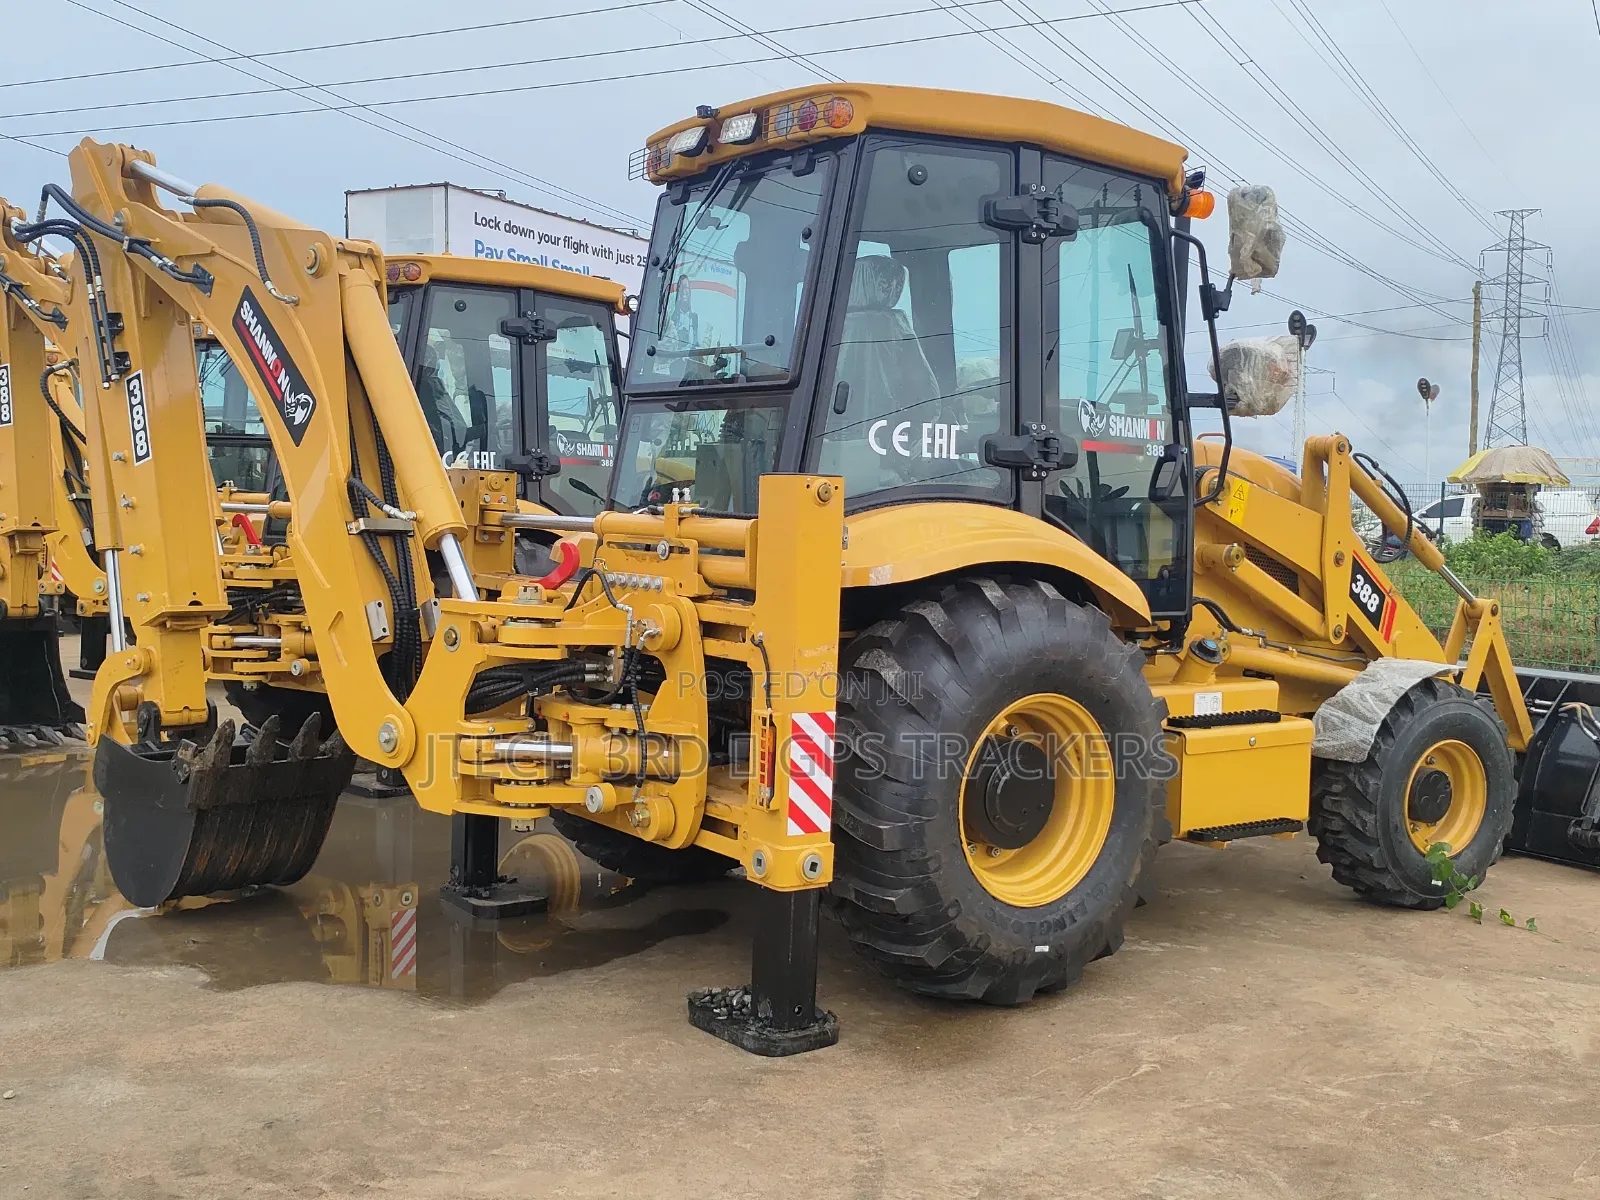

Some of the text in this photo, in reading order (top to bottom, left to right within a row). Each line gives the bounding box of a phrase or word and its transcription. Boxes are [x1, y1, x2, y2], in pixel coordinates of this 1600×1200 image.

[474, 211, 502, 231] Lock
[503, 219, 535, 240] down
[537, 230, 561, 245] your
[562, 235, 590, 255] flight
[591, 243, 614, 261] with
[615, 248, 635, 265] just
[240, 300, 290, 392] SHANMON
[0, 368, 10, 421] 388
[129, 378, 148, 457] 388
[601, 459, 614, 467] 388
[868, 419, 960, 460] CE EAC
[1146, 444, 1165, 457] 388
[1351, 573, 1380, 613] 388
